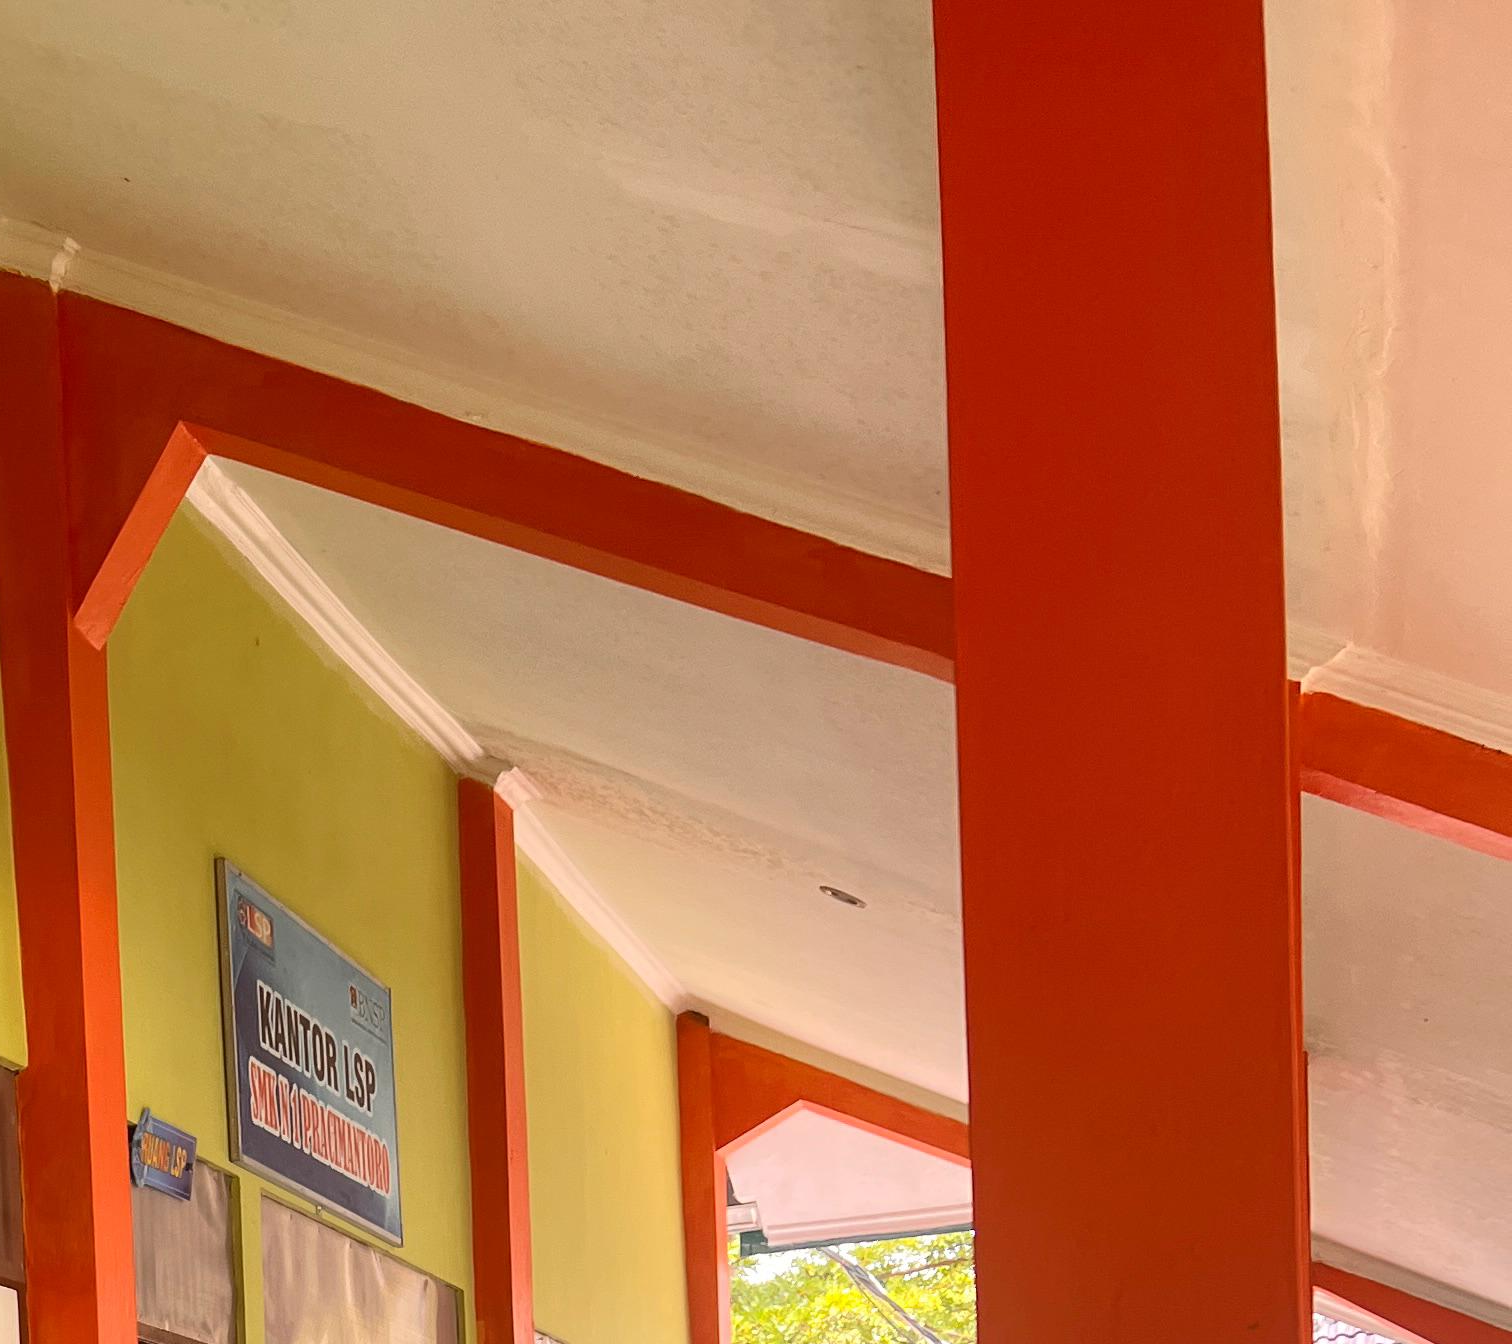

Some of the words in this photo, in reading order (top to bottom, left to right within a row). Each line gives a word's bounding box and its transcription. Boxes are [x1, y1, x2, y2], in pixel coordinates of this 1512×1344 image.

[246, 905, 272, 945] LSP
[257, 982, 340, 1094] KANTOR
[342, 1041, 377, 1115] LSP
[170, 1144, 188, 1178] LSP
[249, 1058, 280, 1135] SMK
[279, 1075, 291, 1142] N
[290, 1084, 301, 1146] 1
[300, 1091, 391, 1196] PRACIMANTORO
